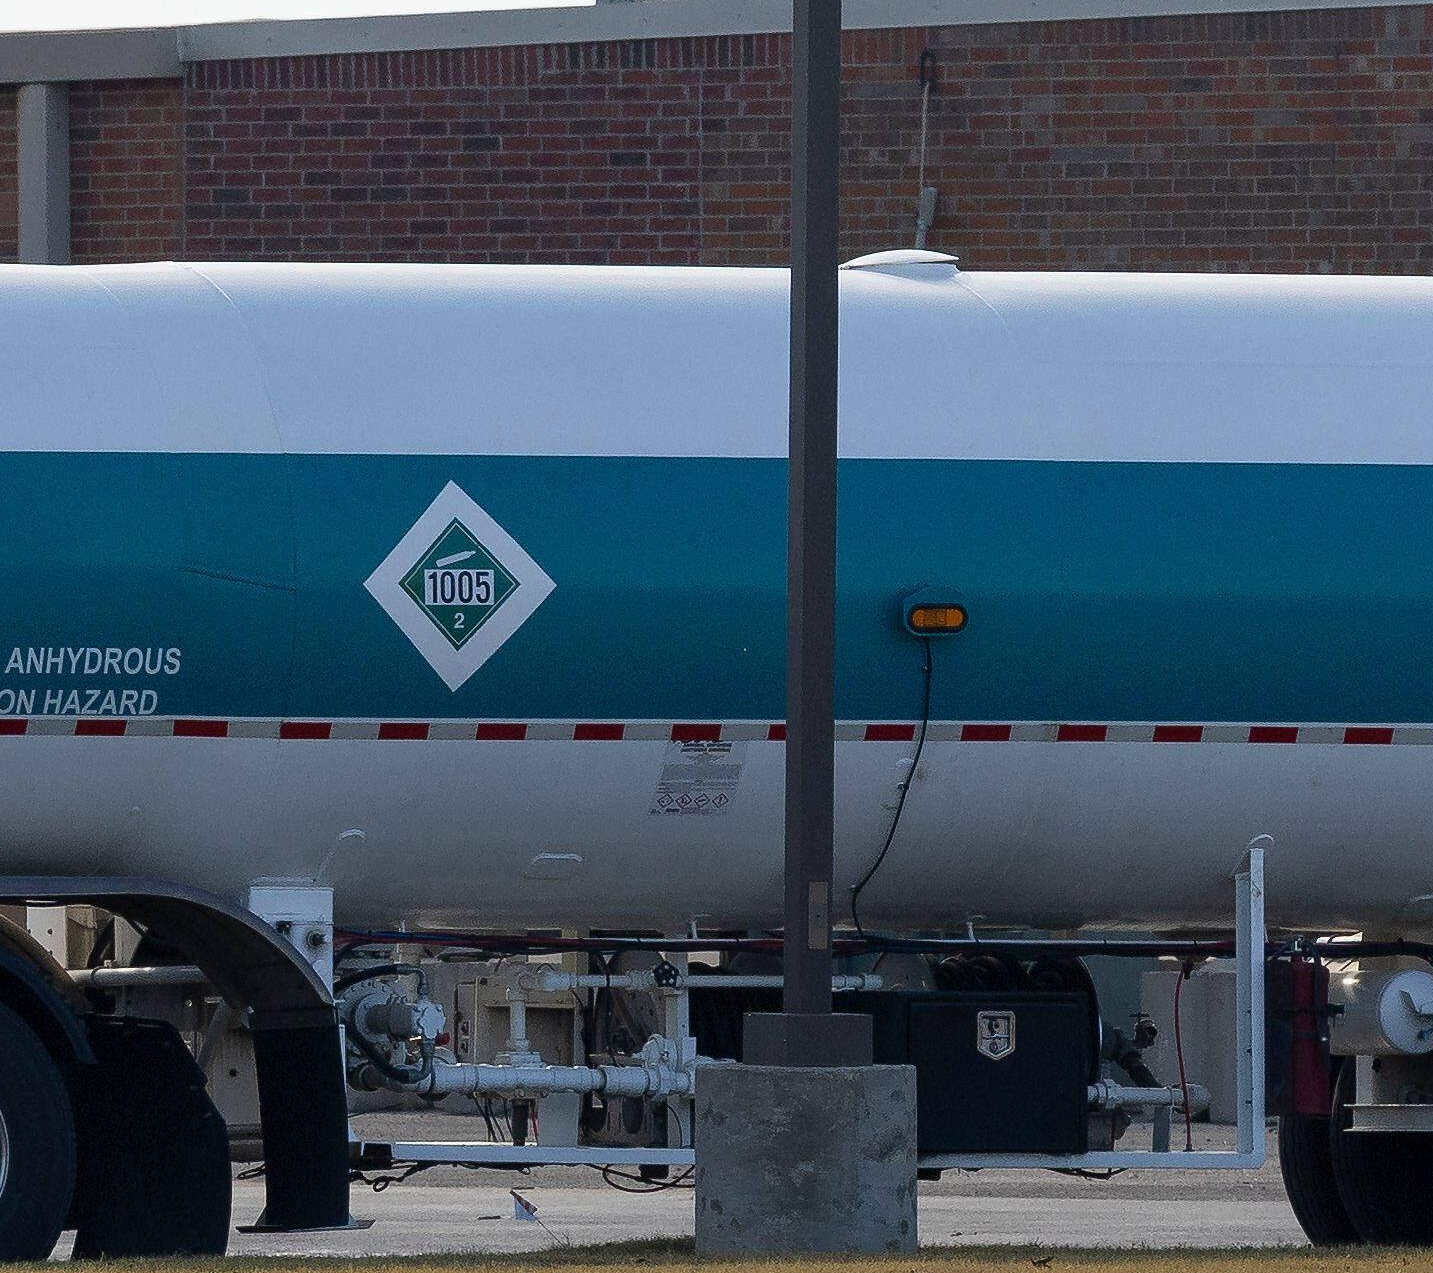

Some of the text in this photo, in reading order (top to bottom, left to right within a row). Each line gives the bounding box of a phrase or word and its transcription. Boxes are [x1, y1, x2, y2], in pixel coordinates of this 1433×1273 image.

[428, 570, 491, 604] 1005
[454, 612, 465, 629] 2
[3, 647, 182, 675] ANHYDROUS
[42, 689, 159, 715] HAZARD
